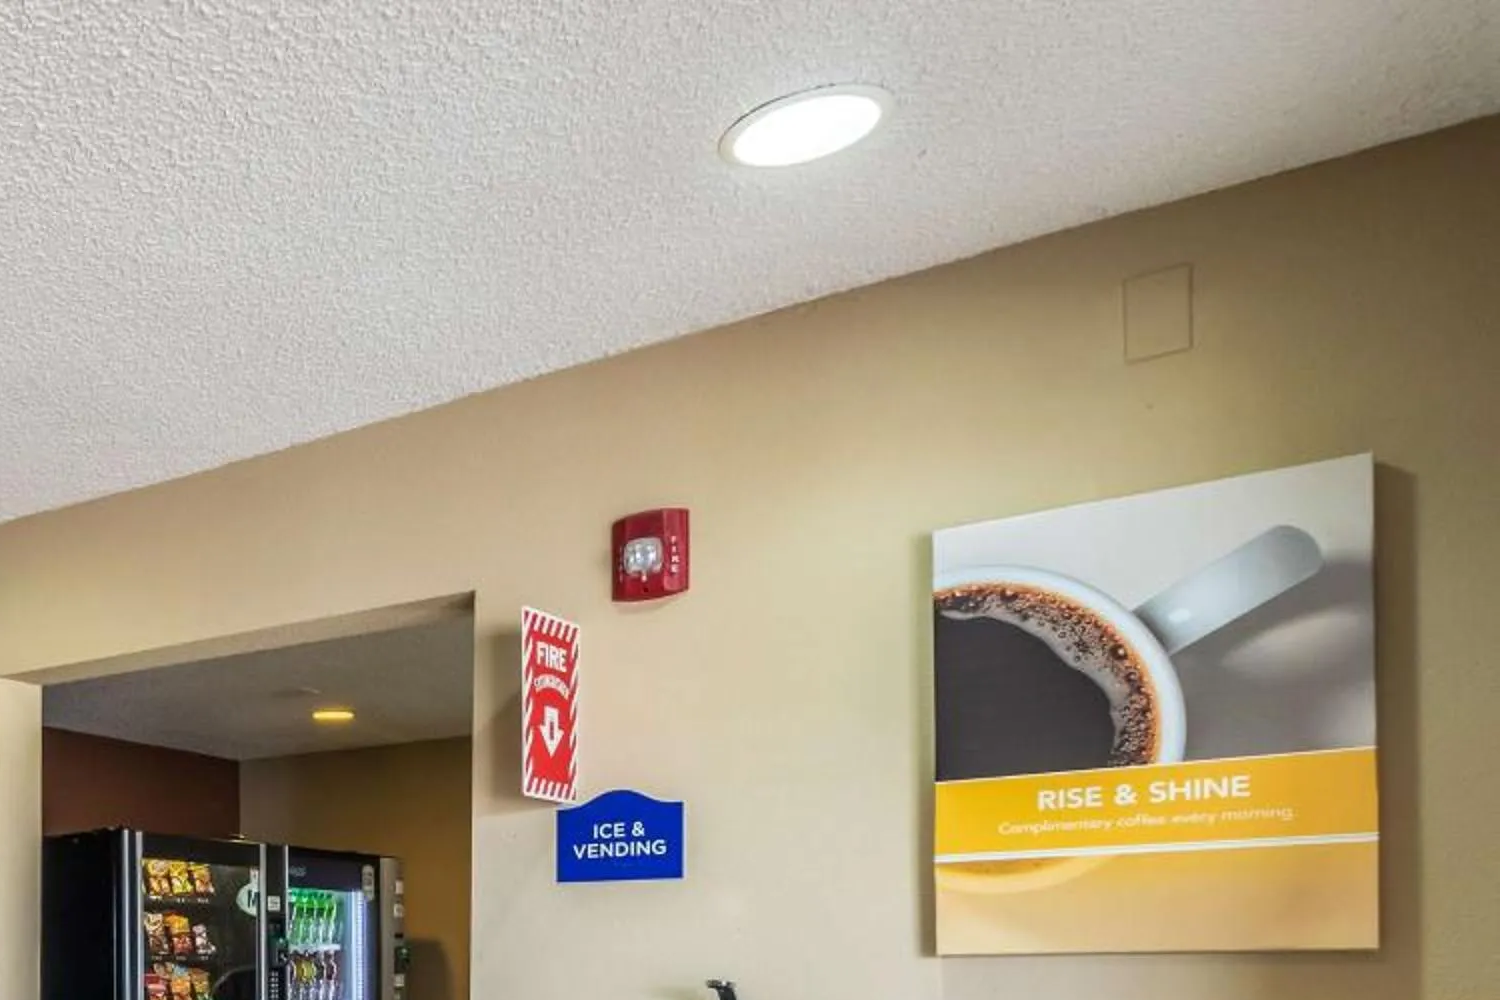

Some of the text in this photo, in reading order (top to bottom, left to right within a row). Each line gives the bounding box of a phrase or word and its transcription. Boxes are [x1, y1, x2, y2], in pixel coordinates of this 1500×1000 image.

[536, 641, 567, 673] FIRE
[1037, 775, 1251, 811] RISE & SHINE
[593, 821, 645, 839] ICE &
[998, 806, 1294, 837] Complimentary coffee every morning
[573, 839, 667, 860] VENDING
